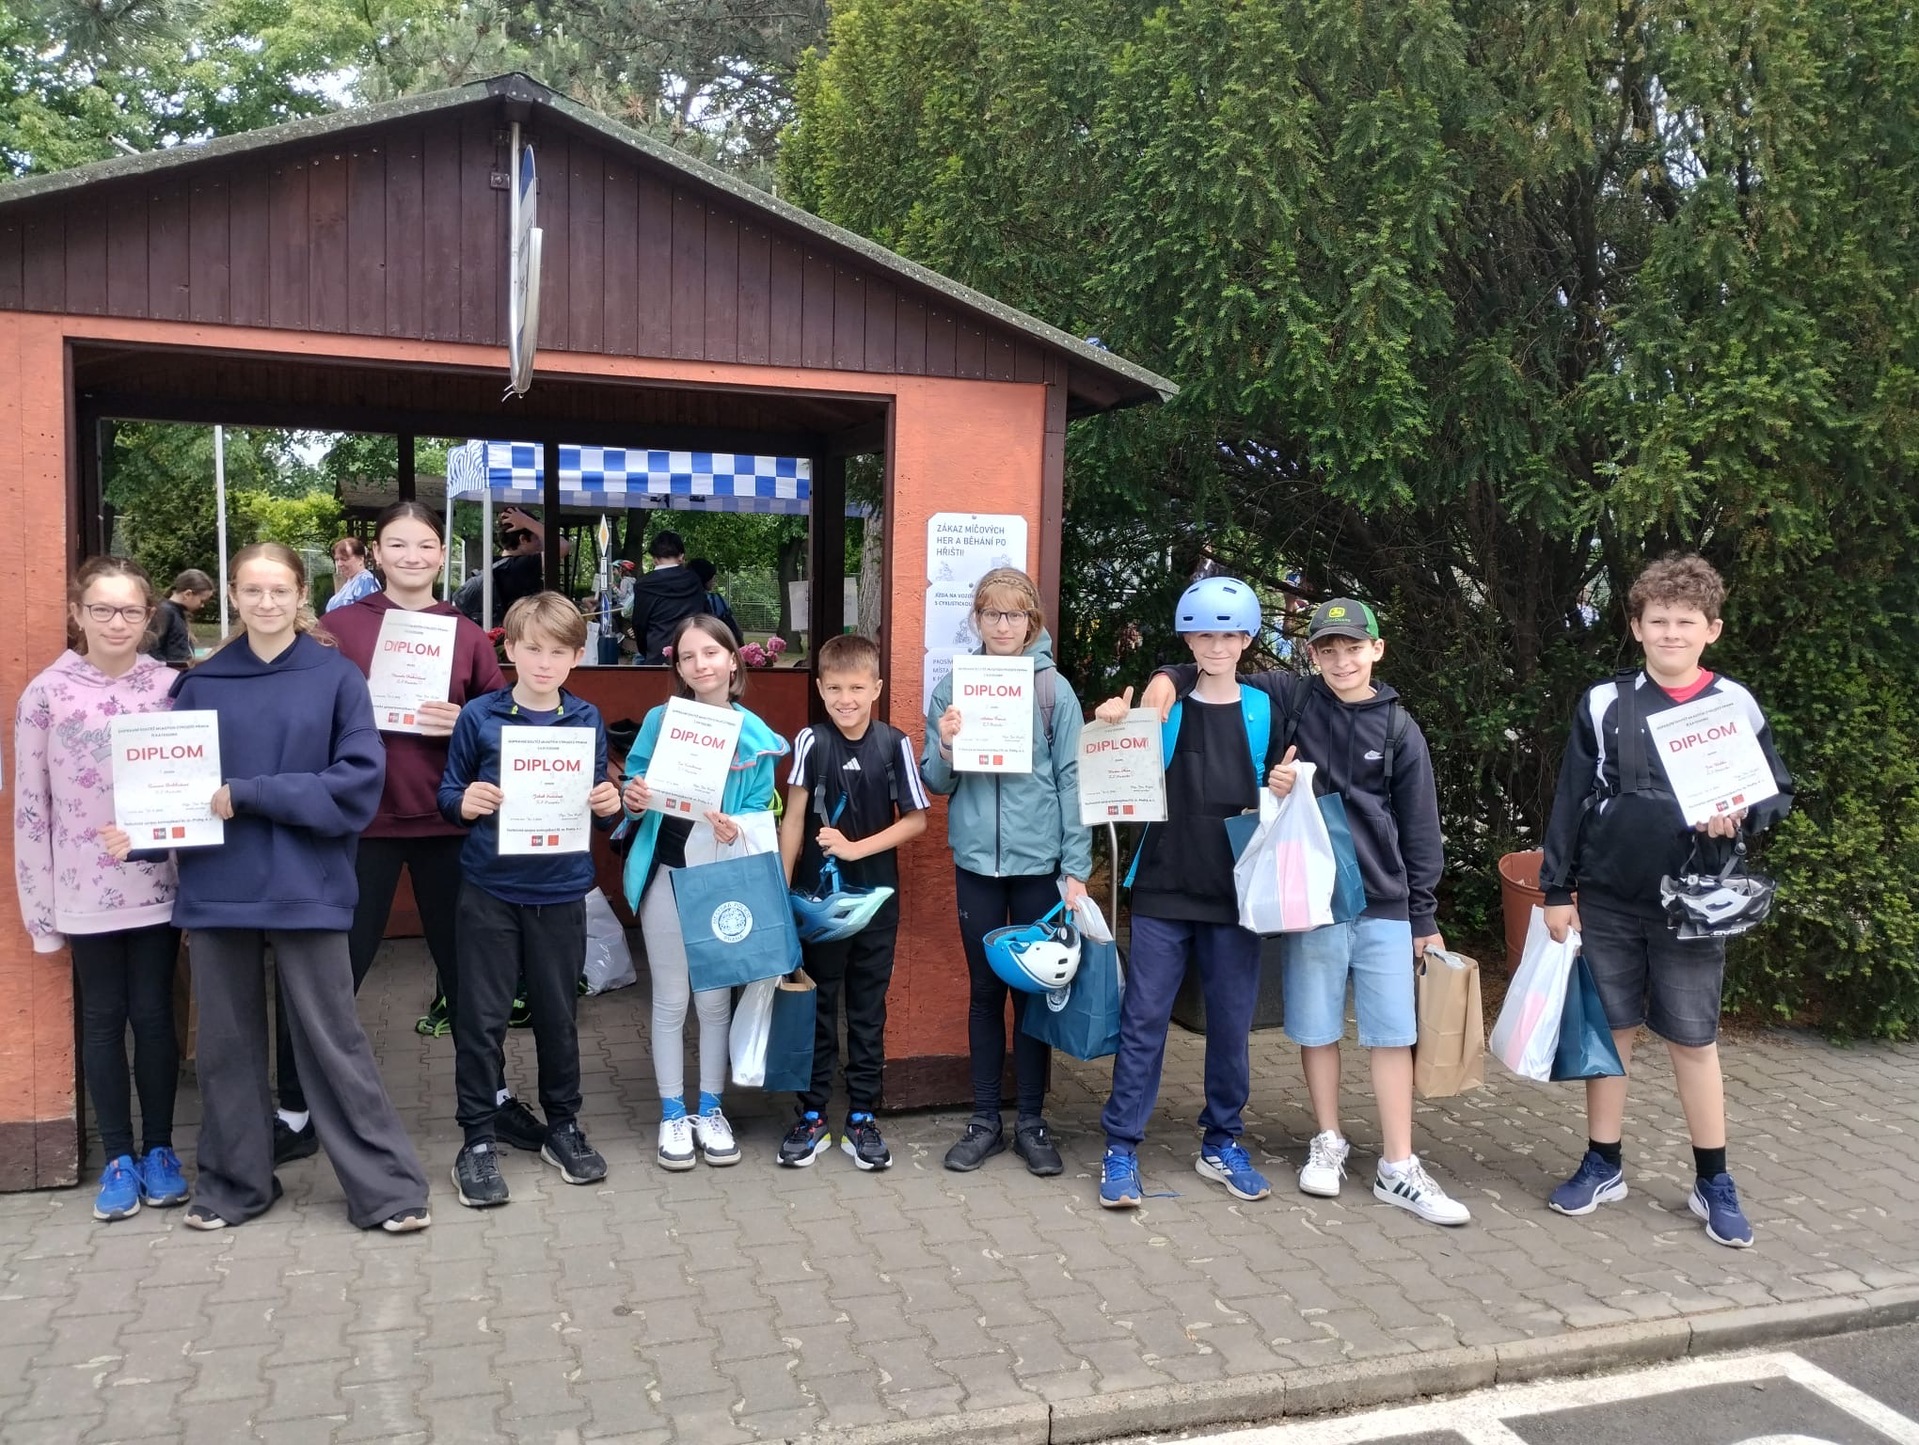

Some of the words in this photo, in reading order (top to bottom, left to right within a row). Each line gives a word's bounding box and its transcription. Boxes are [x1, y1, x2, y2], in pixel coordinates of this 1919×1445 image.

[937, 523, 962, 533] ZÁKAZ
[965, 524, 1005, 535] MÍČOVÝCH
[936, 536, 953, 545] HER
[955, 537, 961, 545] A
[963, 536, 993, 546] BĚHÁNÍ
[995, 538, 1006, 546] PO
[384, 640, 441, 657] DIPLOM
[964, 684, 1021, 697] DIPLOM
[670, 727, 726, 750] DIPLOM
[1669, 721, 1737, 753] DIPLOM
[127, 745, 203, 761] DIPLOM
[1086, 737, 1149, 754] DIPLOM
[514, 759, 581, 772] DIPLOM
